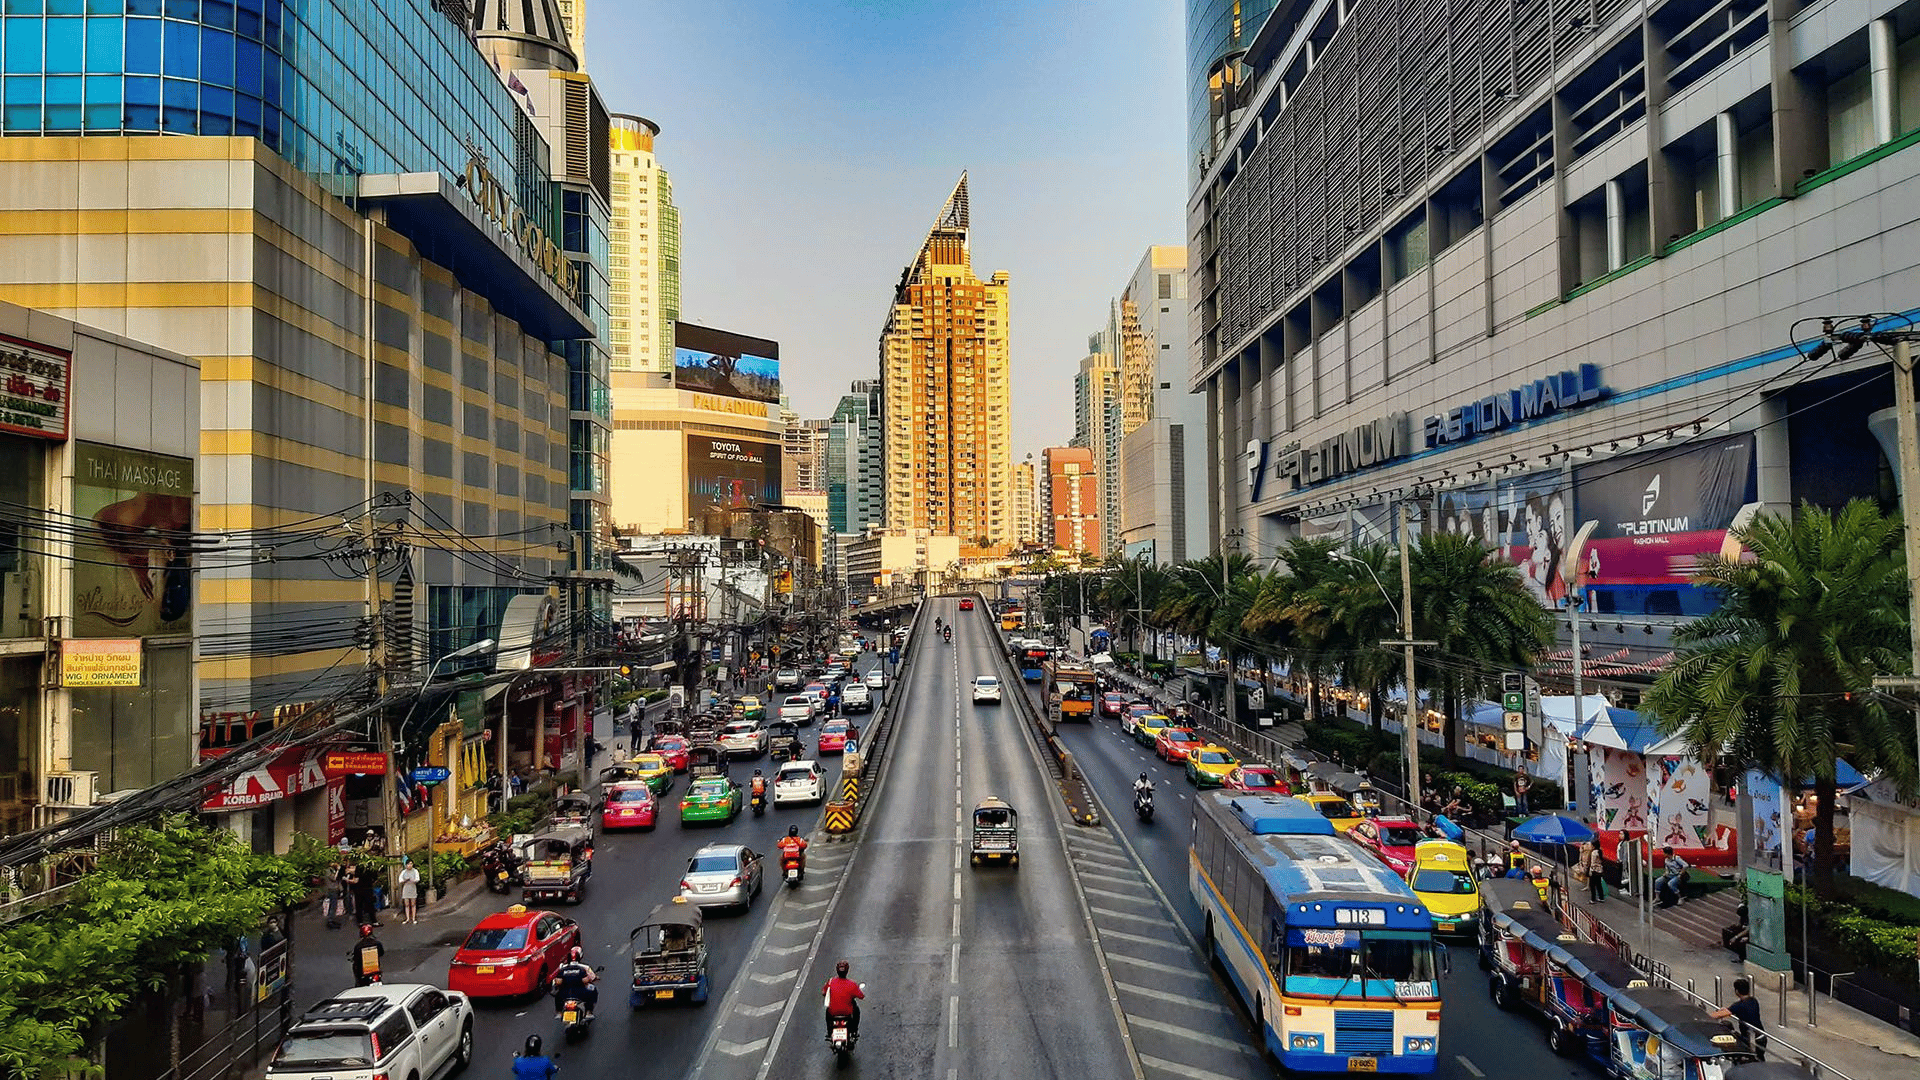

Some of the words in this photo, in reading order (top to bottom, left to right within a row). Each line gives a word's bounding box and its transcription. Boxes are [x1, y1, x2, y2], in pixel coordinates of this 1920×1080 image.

[466, 157, 510, 233] CITY
[694, 393, 768, 417] PALLADIUM
[1424, 391, 1514, 449] FASHION
[1520, 363, 1600, 420] MALL
[712, 441, 740, 452] TOYOTA
[87, 458, 118, 480] THAI
[121, 465, 181, 489] MASSAGE
[1634, 537, 1654, 545] FASHION
[200, 711, 260, 743] ITY
[437, 768, 446, 776] 21
[223, 794, 256, 805] KOREA
[259, 791, 283, 802] BRAND
[1349, 909, 1370, 924] 113
